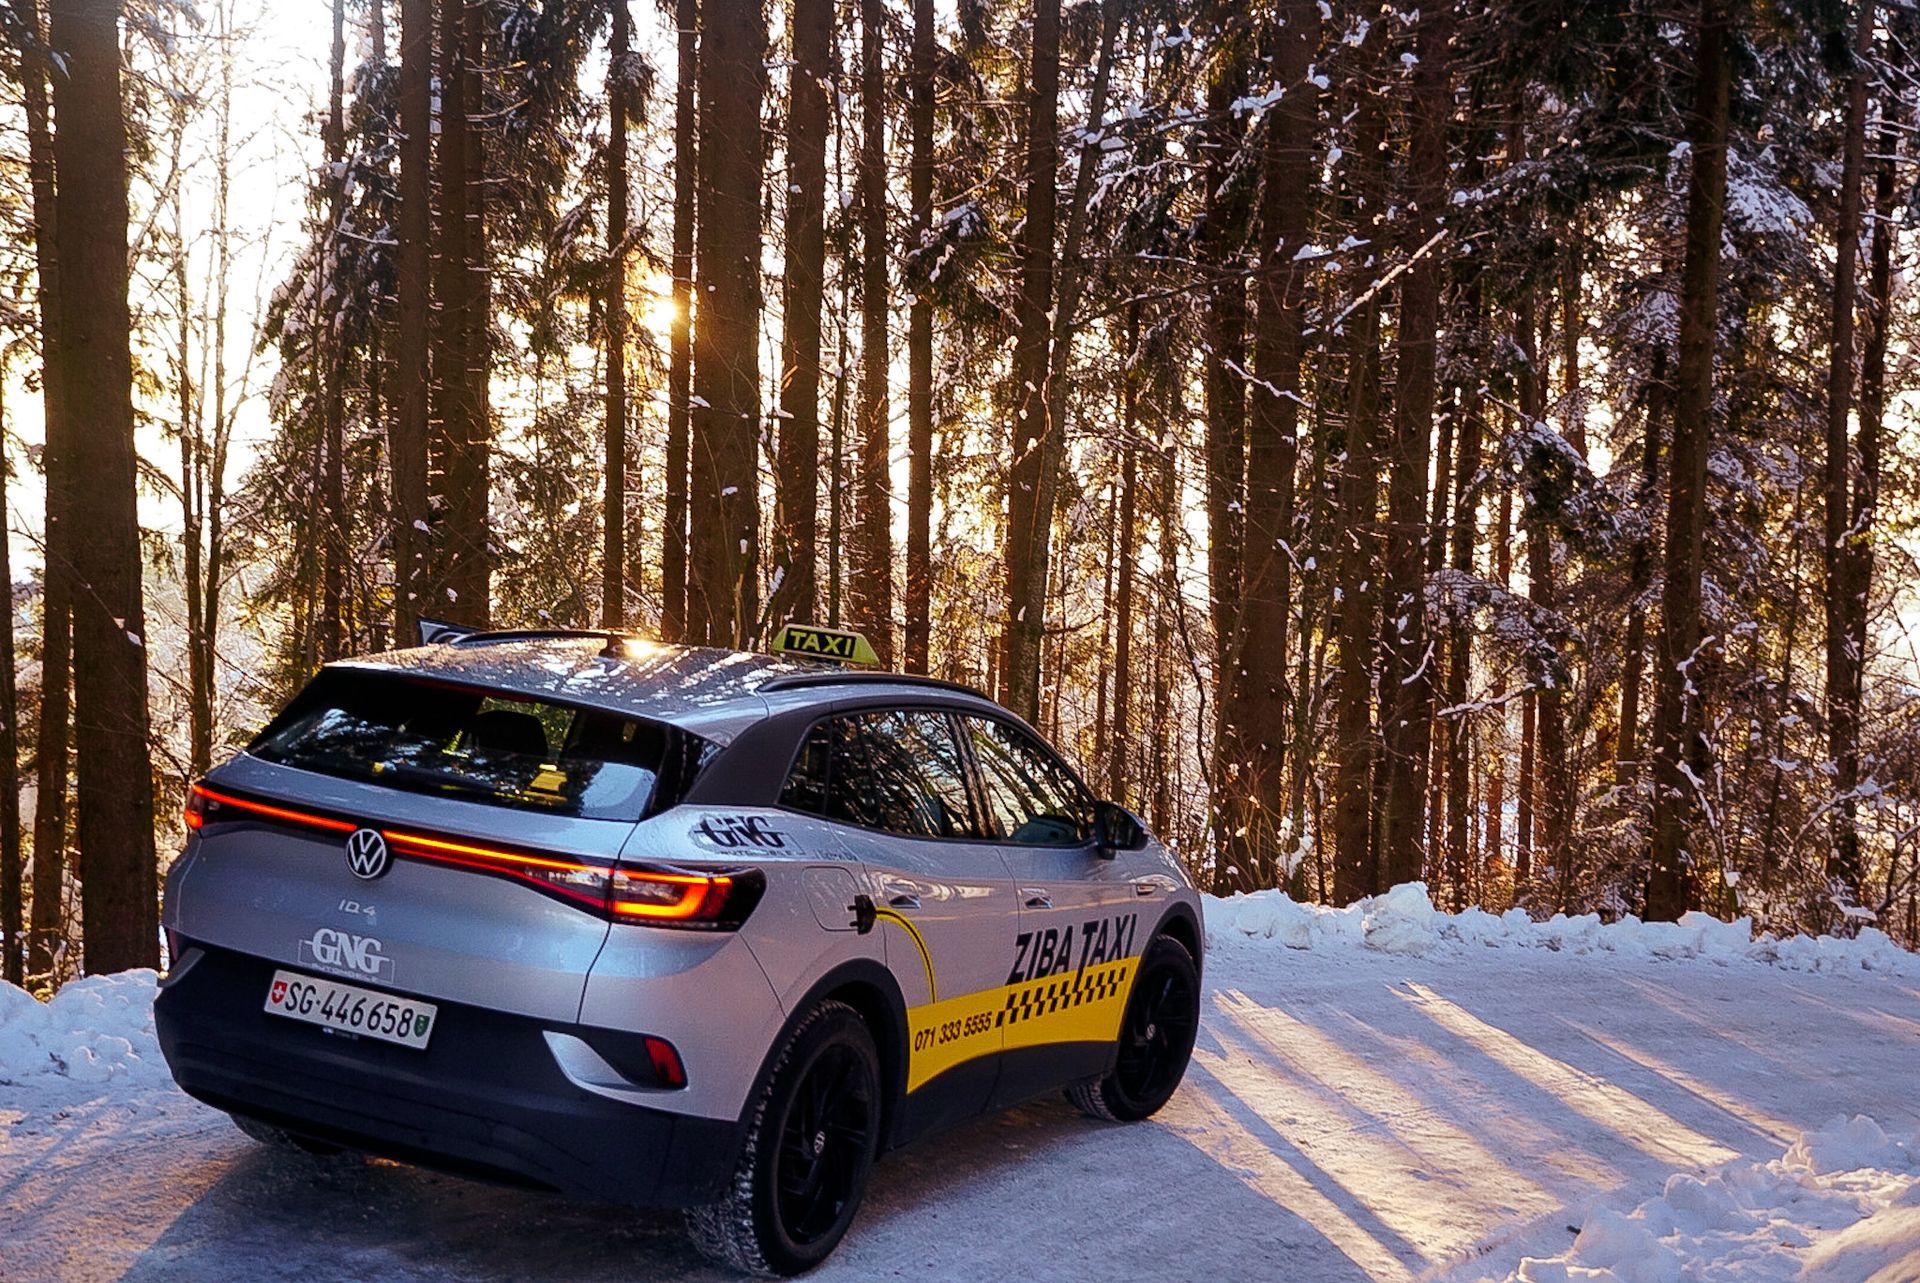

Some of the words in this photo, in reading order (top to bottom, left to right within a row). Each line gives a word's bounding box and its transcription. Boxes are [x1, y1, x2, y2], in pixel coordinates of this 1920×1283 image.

[789, 630, 854, 656] TAXI
[347, 829, 387, 879] VW
[694, 816, 786, 848] GNG
[304, 928, 391, 974] GNG
[1005, 925, 1074, 986] ZIBA
[1071, 913, 1138, 993] TAXI
[914, 1026, 936, 1052] 071
[938, 1019, 962, 1045] 333
[963, 1010, 993, 1038] 5555
